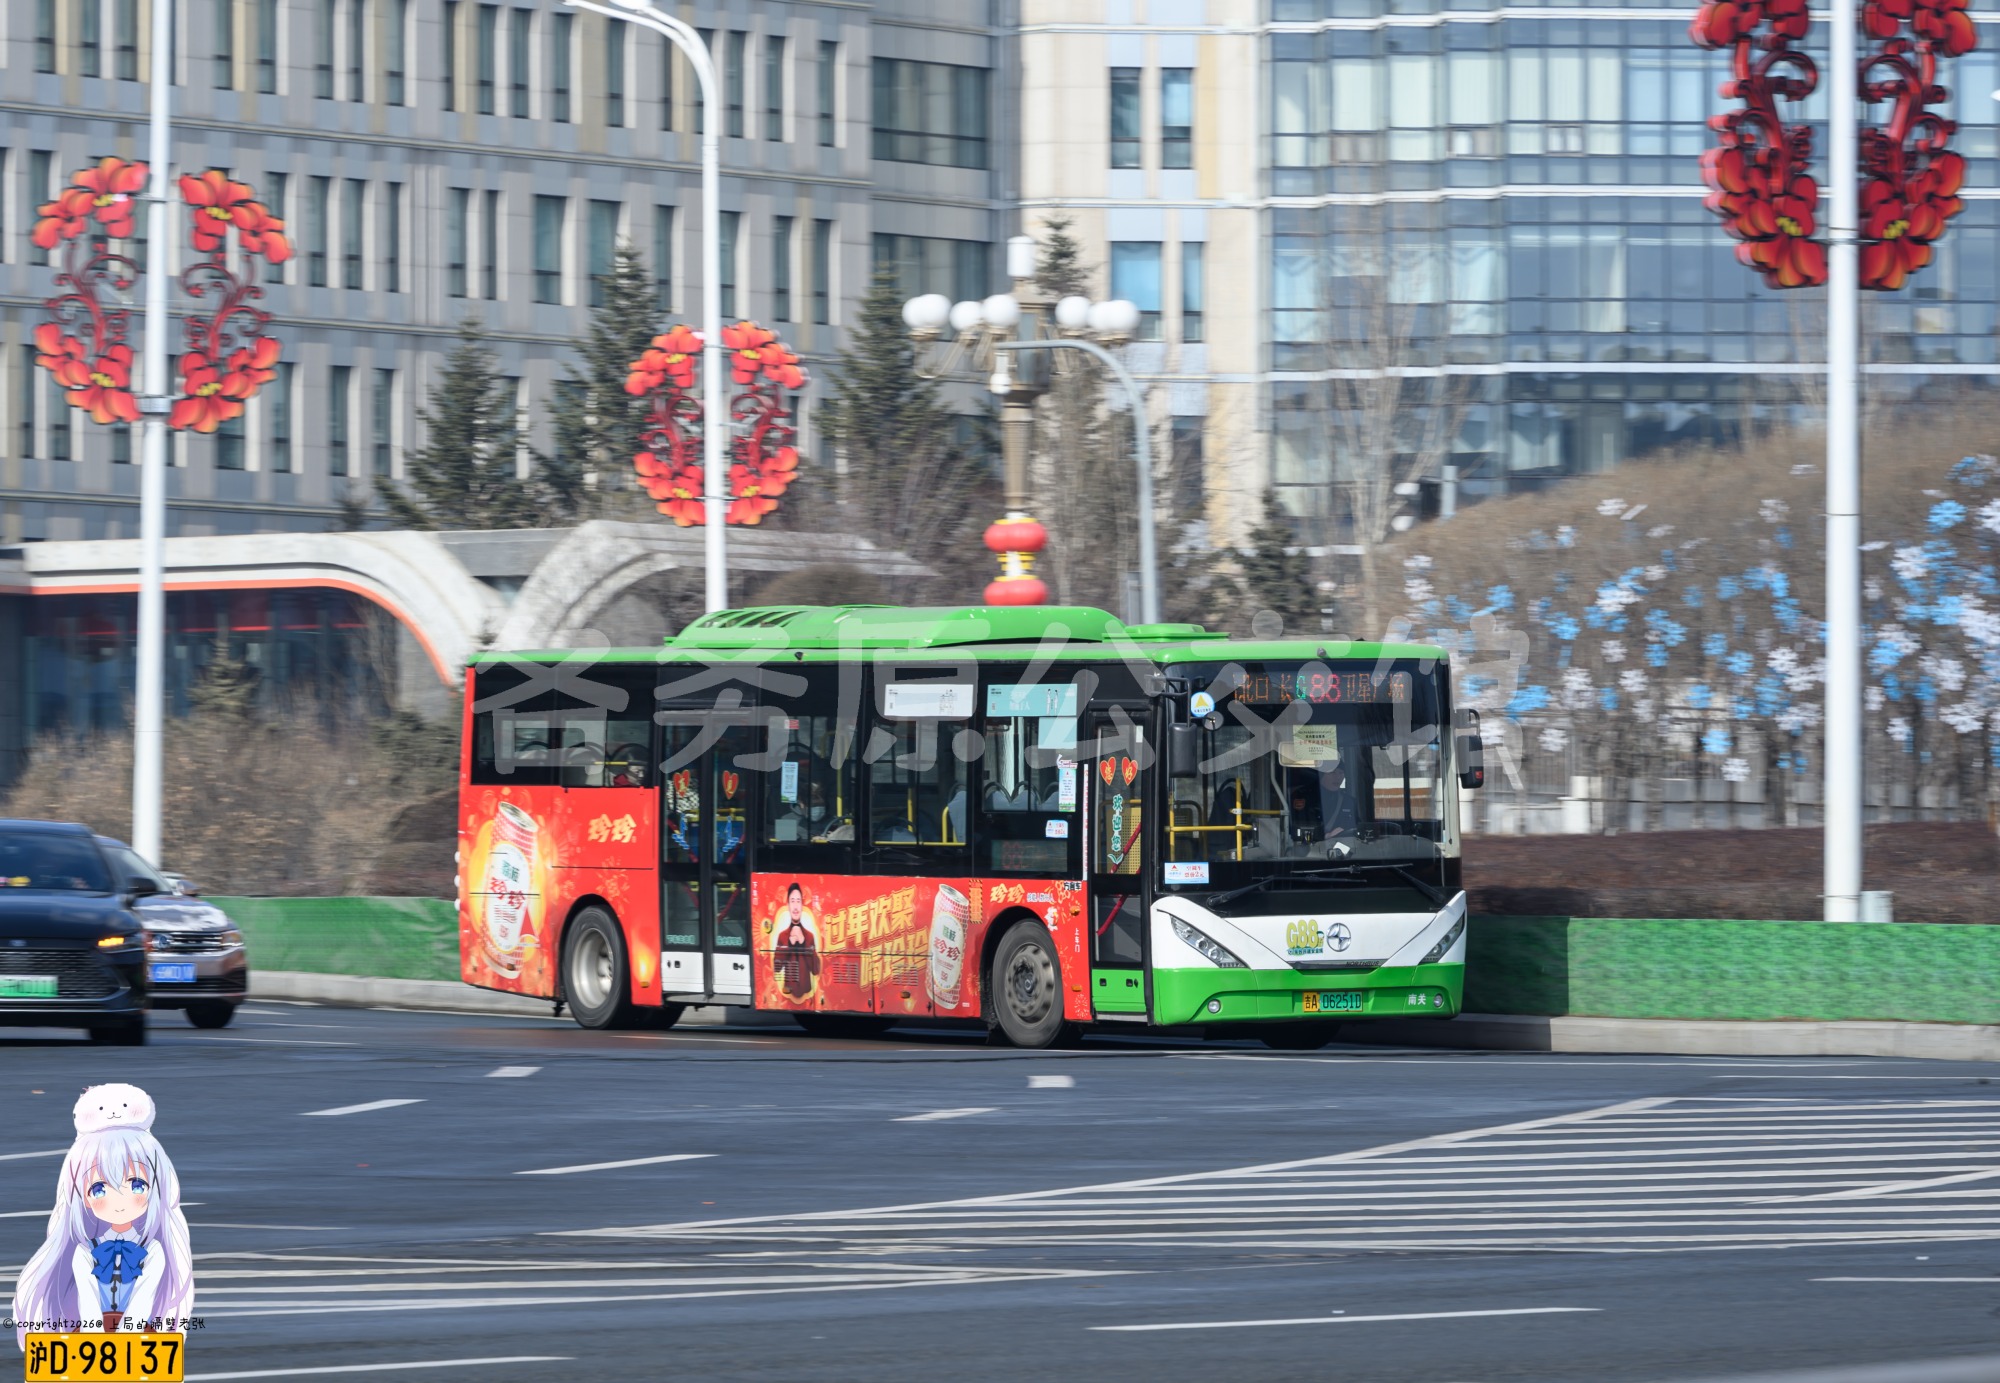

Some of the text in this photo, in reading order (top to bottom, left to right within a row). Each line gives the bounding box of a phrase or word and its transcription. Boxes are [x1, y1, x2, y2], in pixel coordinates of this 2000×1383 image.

[990, 883, 1025, 904] 珍珍
[824, 885, 917, 957] 过年欢聚
[1286, 919, 1319, 949] G88
[1408, 993, 1427, 1006] 南关
